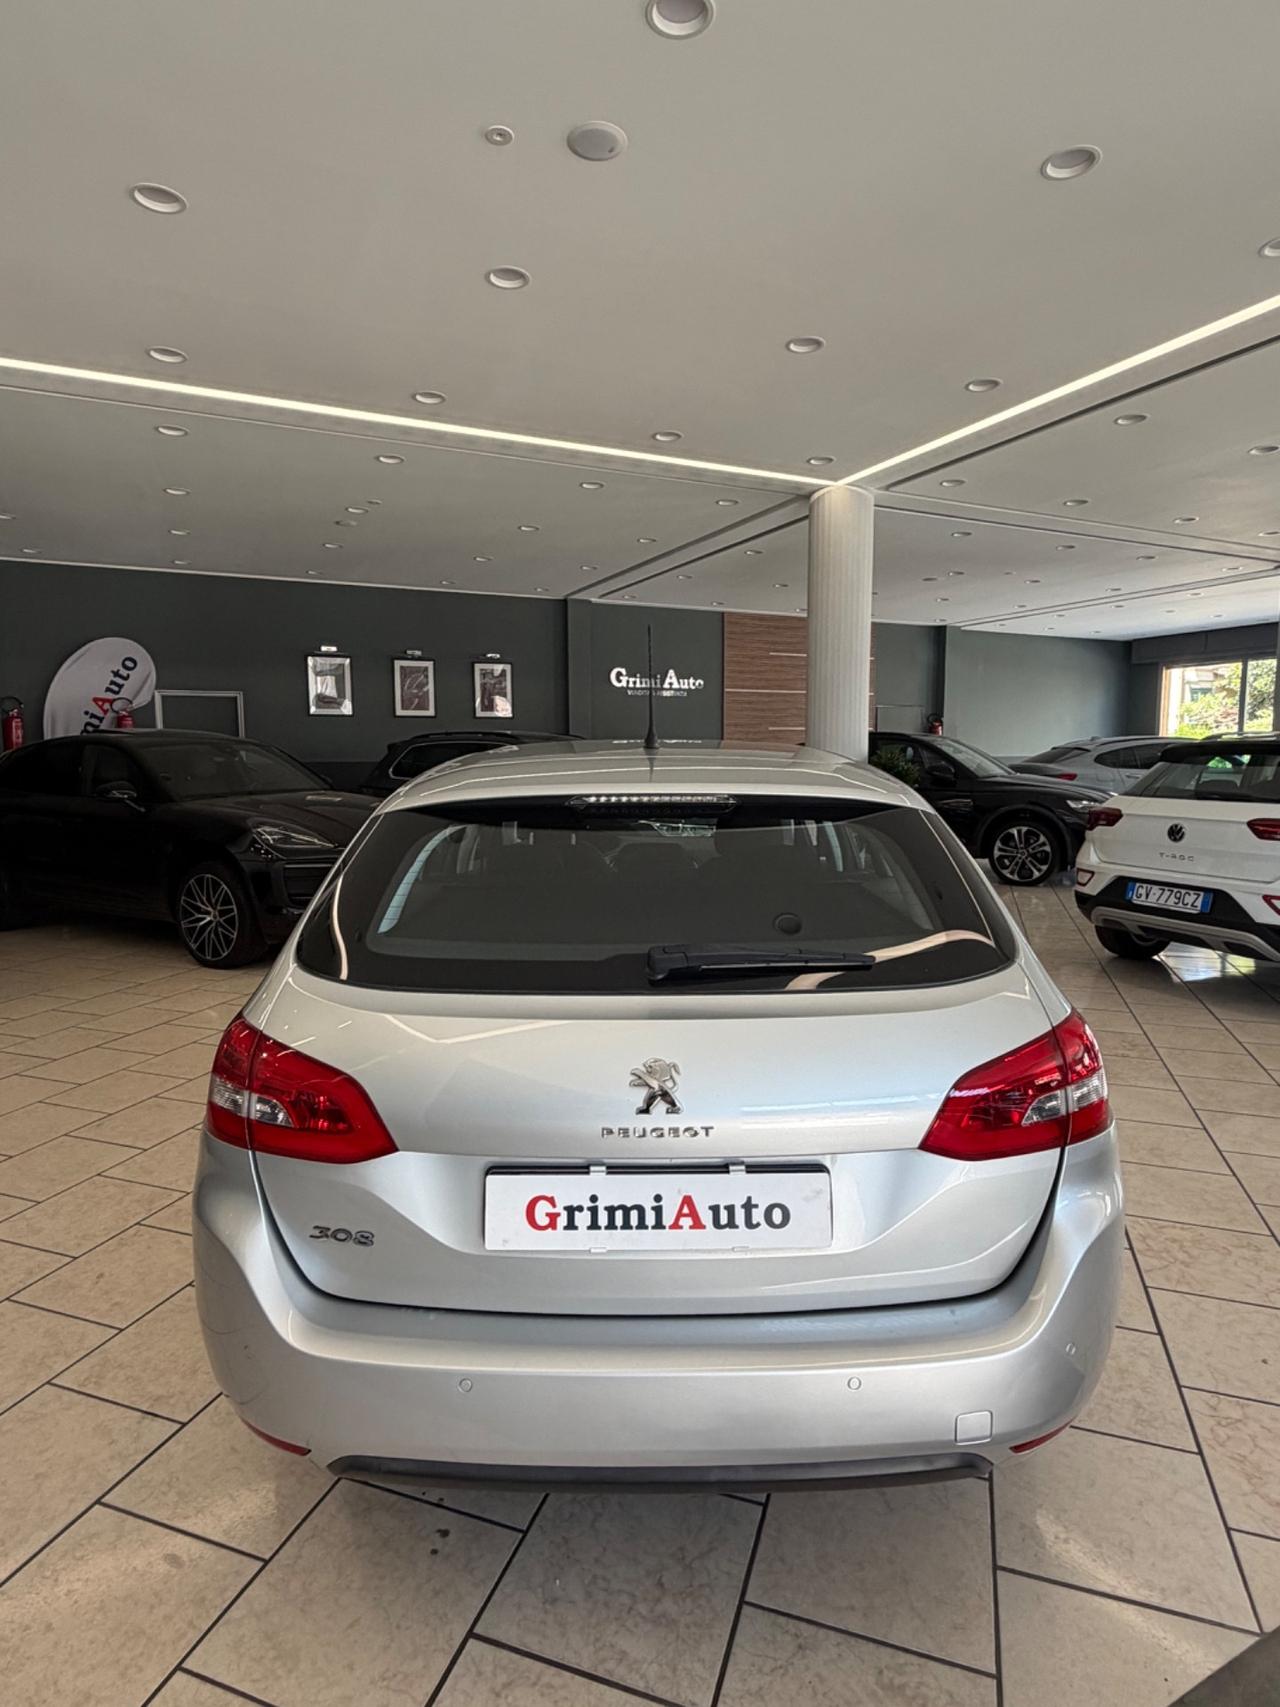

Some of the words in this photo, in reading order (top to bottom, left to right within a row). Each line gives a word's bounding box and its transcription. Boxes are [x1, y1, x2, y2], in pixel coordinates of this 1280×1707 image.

[601, 1126, 714, 1138] PEUGEOT
[525, 1194, 791, 1231] GrimiAuto
[309, 1225, 375, 1247] 308
